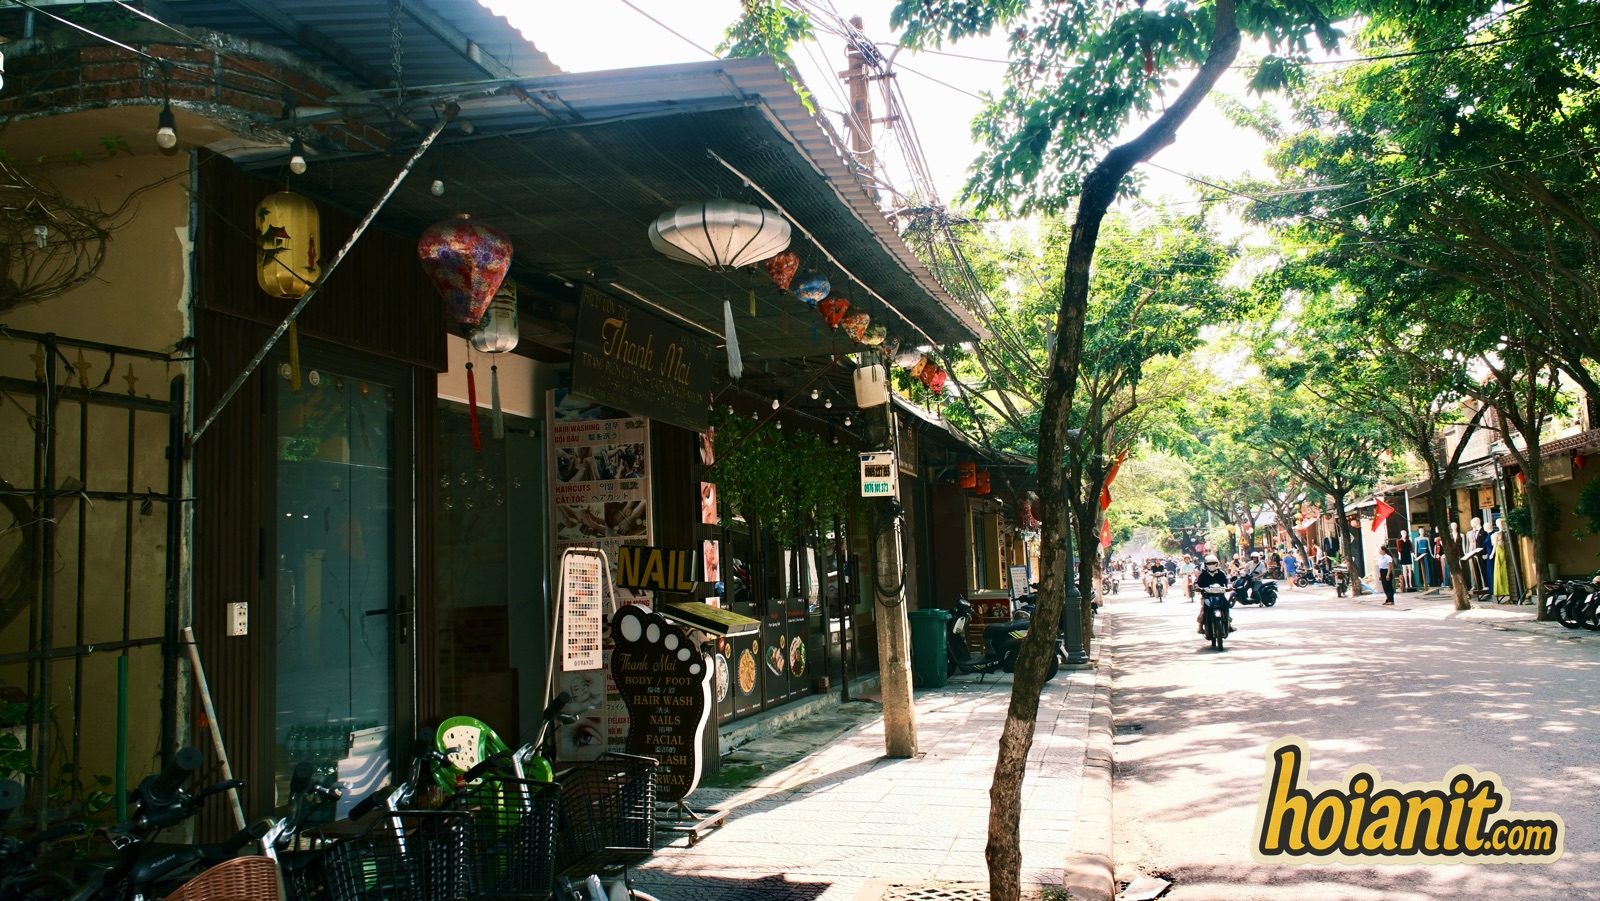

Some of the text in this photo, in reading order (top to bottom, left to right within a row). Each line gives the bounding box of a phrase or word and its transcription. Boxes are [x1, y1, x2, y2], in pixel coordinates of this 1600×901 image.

[601, 317, 691, 386] Thanh Mai
[554, 424, 600, 433] HAIR WASHING
[556, 485, 591, 493] HAIRCUTS
[617, 547, 693, 592] NAIL
[619, 653, 677, 672] Thanh Mai
[625, 676, 653, 684] BODY
[665, 677, 692, 686] FOOT
[633, 695, 660, 705] HAIR
[663, 696, 693, 706] WASH
[650, 715, 681, 725] NAILS
[646, 735, 684, 745] FACIAL
[656, 774, 685, 785] RWAX
